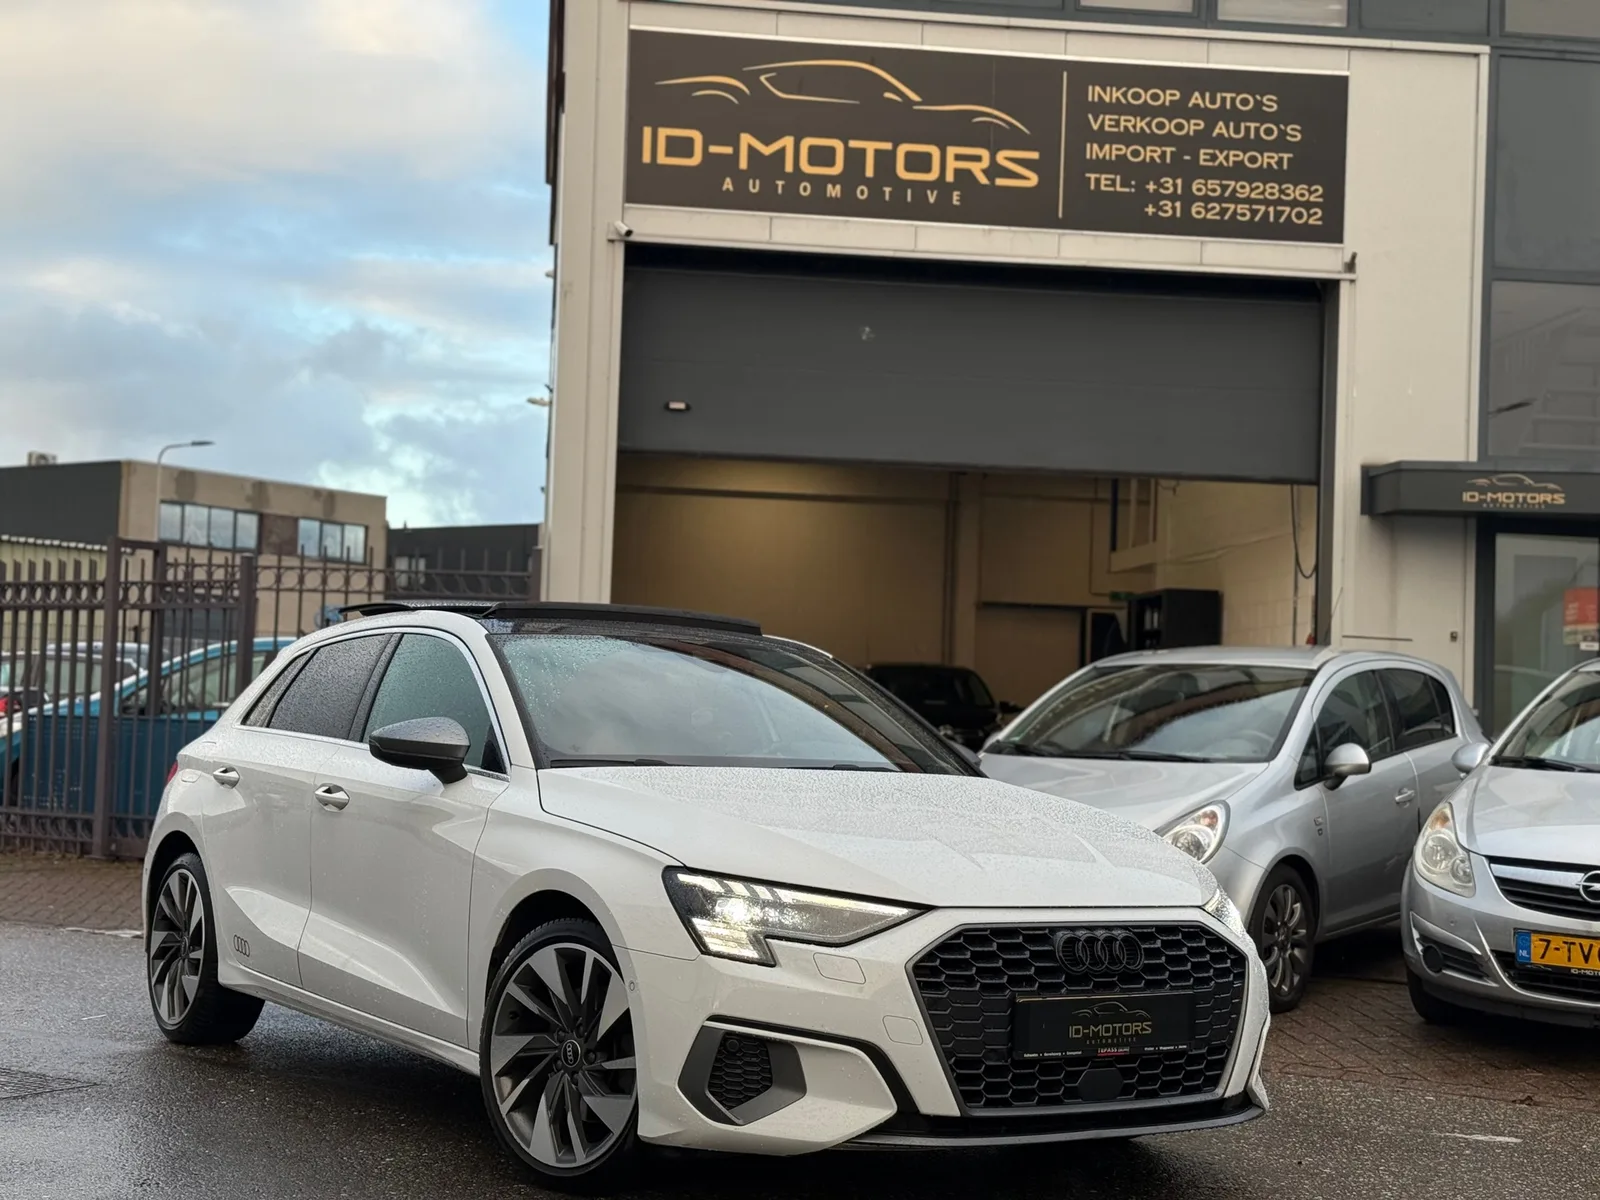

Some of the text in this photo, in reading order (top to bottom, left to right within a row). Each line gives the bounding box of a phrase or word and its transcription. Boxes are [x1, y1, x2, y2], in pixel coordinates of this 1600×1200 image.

[1088, 85, 1181, 106] INKOOP
[1088, 113, 1205, 136] VERKOOP
[642, 126, 1040, 188] ID-MOTORS
[1085, 142, 1176, 164] IMPORT
[1199, 149, 1293, 170] EXPORT
[722, 177, 961, 206] AUTOMOTIVE
[1085, 173, 1324, 203] TEL: +31 657928362
[1144, 200, 1323, 225] +31 627571702
[1462, 491, 1565, 504] ID-MOTORS
[1519, 949, 1529, 957] NL
[1538, 938, 1600, 964] 7-TV
[1069, 1021, 1152, 1038] ID-MOTORS
